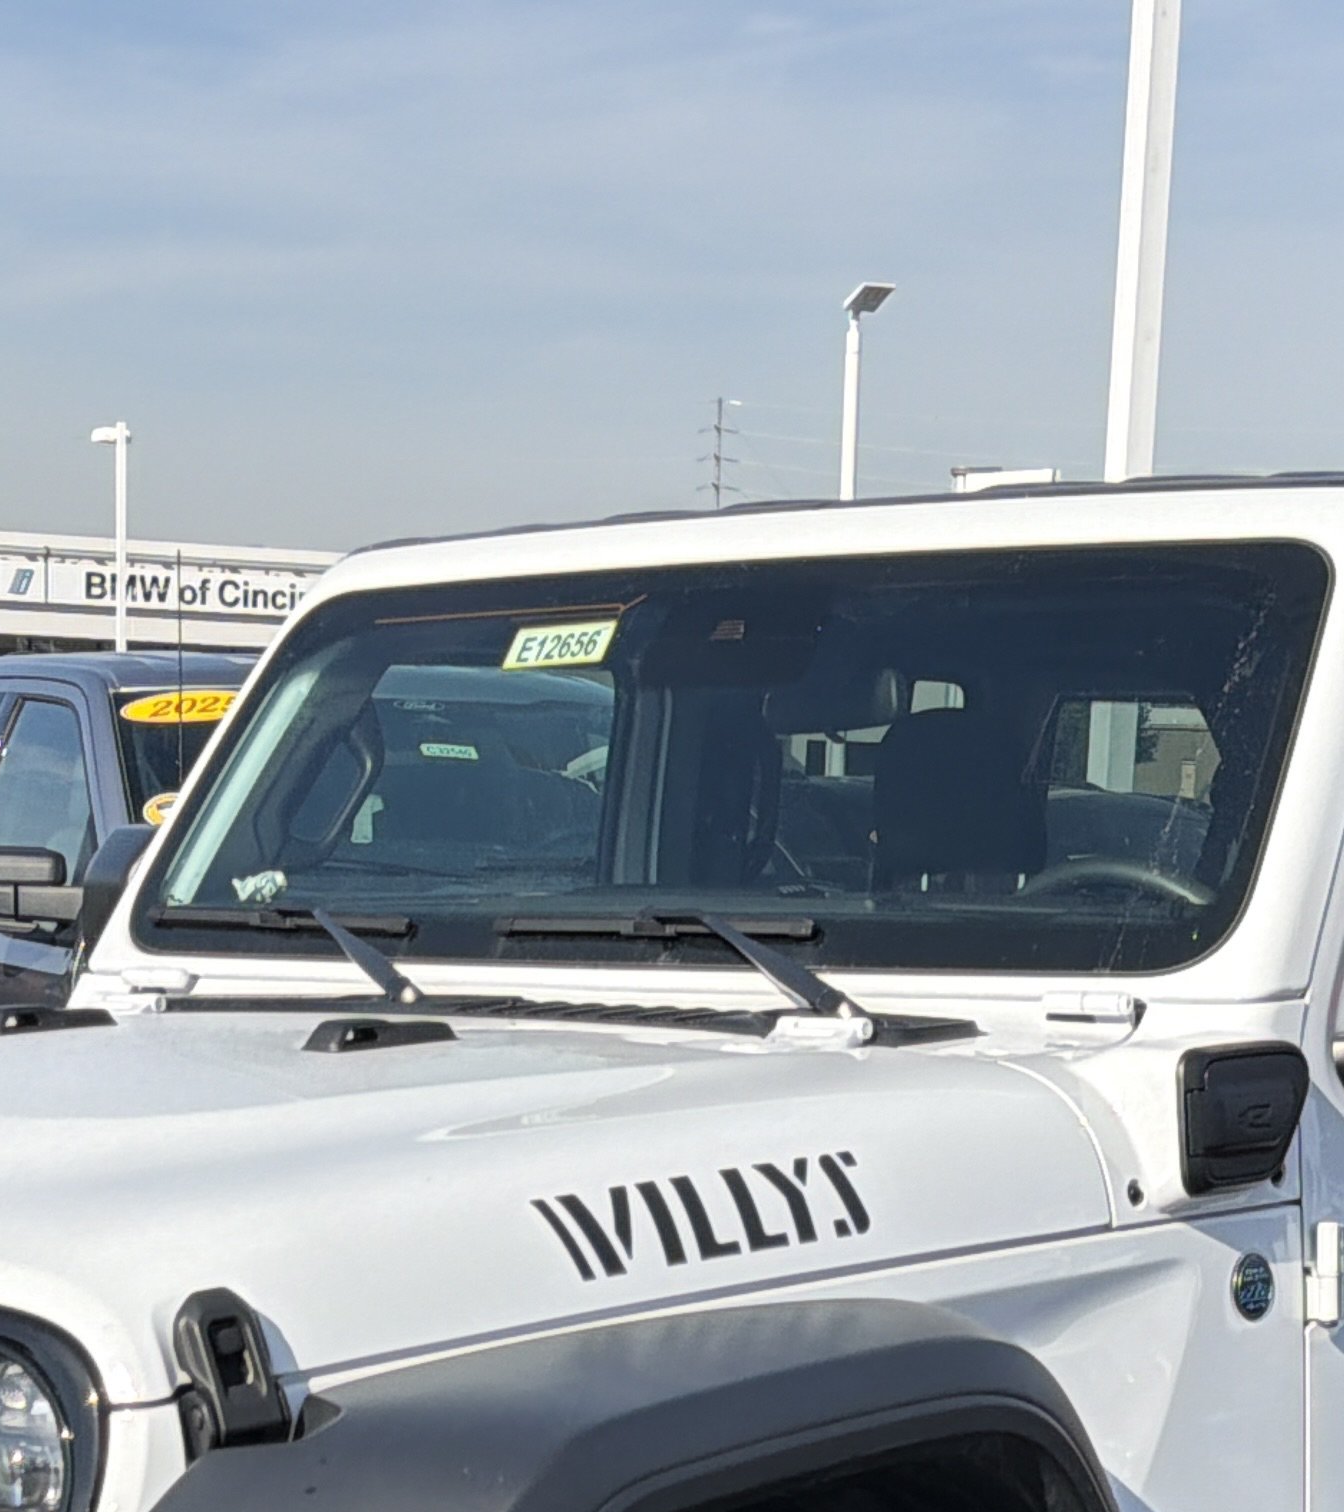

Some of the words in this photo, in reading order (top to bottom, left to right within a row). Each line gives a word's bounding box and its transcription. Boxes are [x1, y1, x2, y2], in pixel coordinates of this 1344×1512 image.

[85, 571, 171, 603] BMW
[179, 578, 211, 605] of
[217, 579, 308, 611] Cinci
[516, 629, 602, 663] E12656
[530, 1150, 871, 1282] WILLYS
